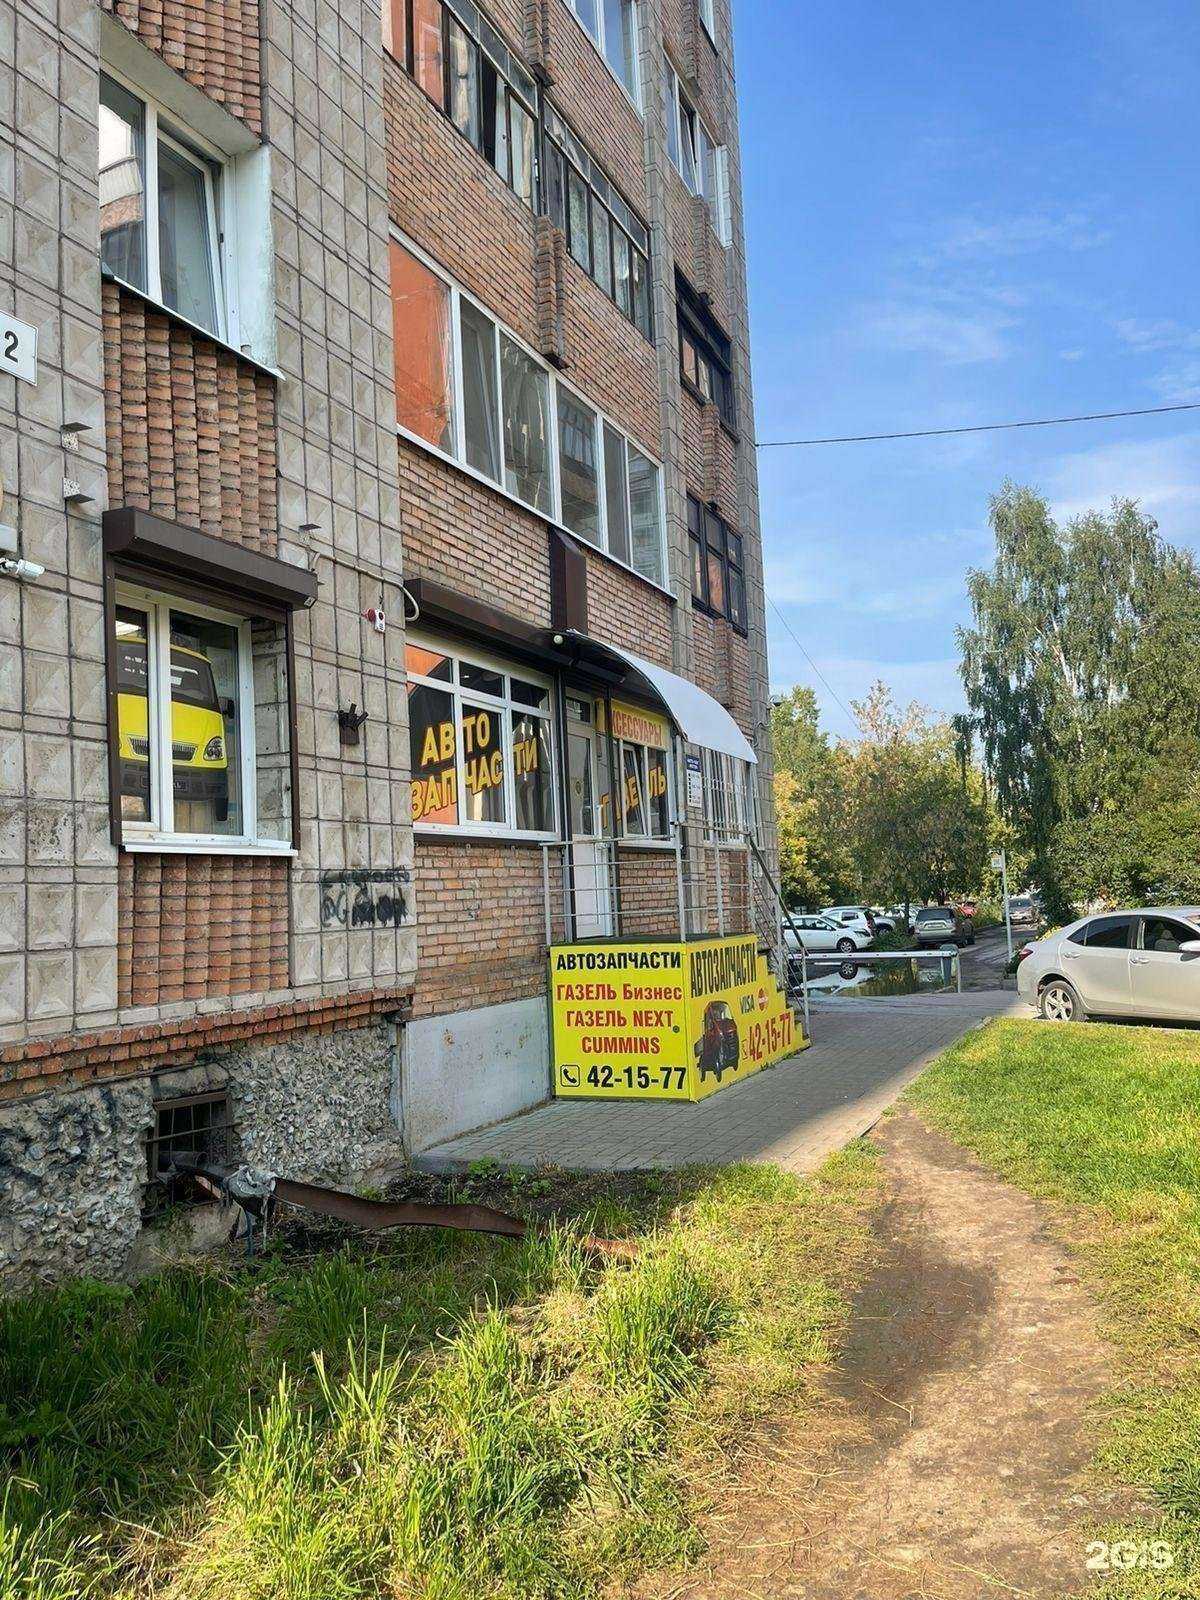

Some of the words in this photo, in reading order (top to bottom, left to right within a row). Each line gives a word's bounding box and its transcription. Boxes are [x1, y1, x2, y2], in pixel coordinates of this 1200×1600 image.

[4, 330, 19, 363] 2
[421, 711, 491, 768] АВТО
[600, 764, 667, 829] ГЕЛЬ
[556, 951, 681, 971] АВТОЗАПЧАСТИ
[690, 943, 757, 998] АВТОЗАПЧАСТИ
[556, 983, 618, 1001] ГАЗЕЛЬ
[622, 983, 683, 1001] Бизнес
[566, 1010, 627, 1028] ГАЗЕЛЬ
[633, 1010, 674, 1028] NEXT
[581, 1036, 661, 1054] CUMMINS
[749, 1012, 791, 1061] 42-15-77
[587, 1065, 687, 1089] 42-15-77
